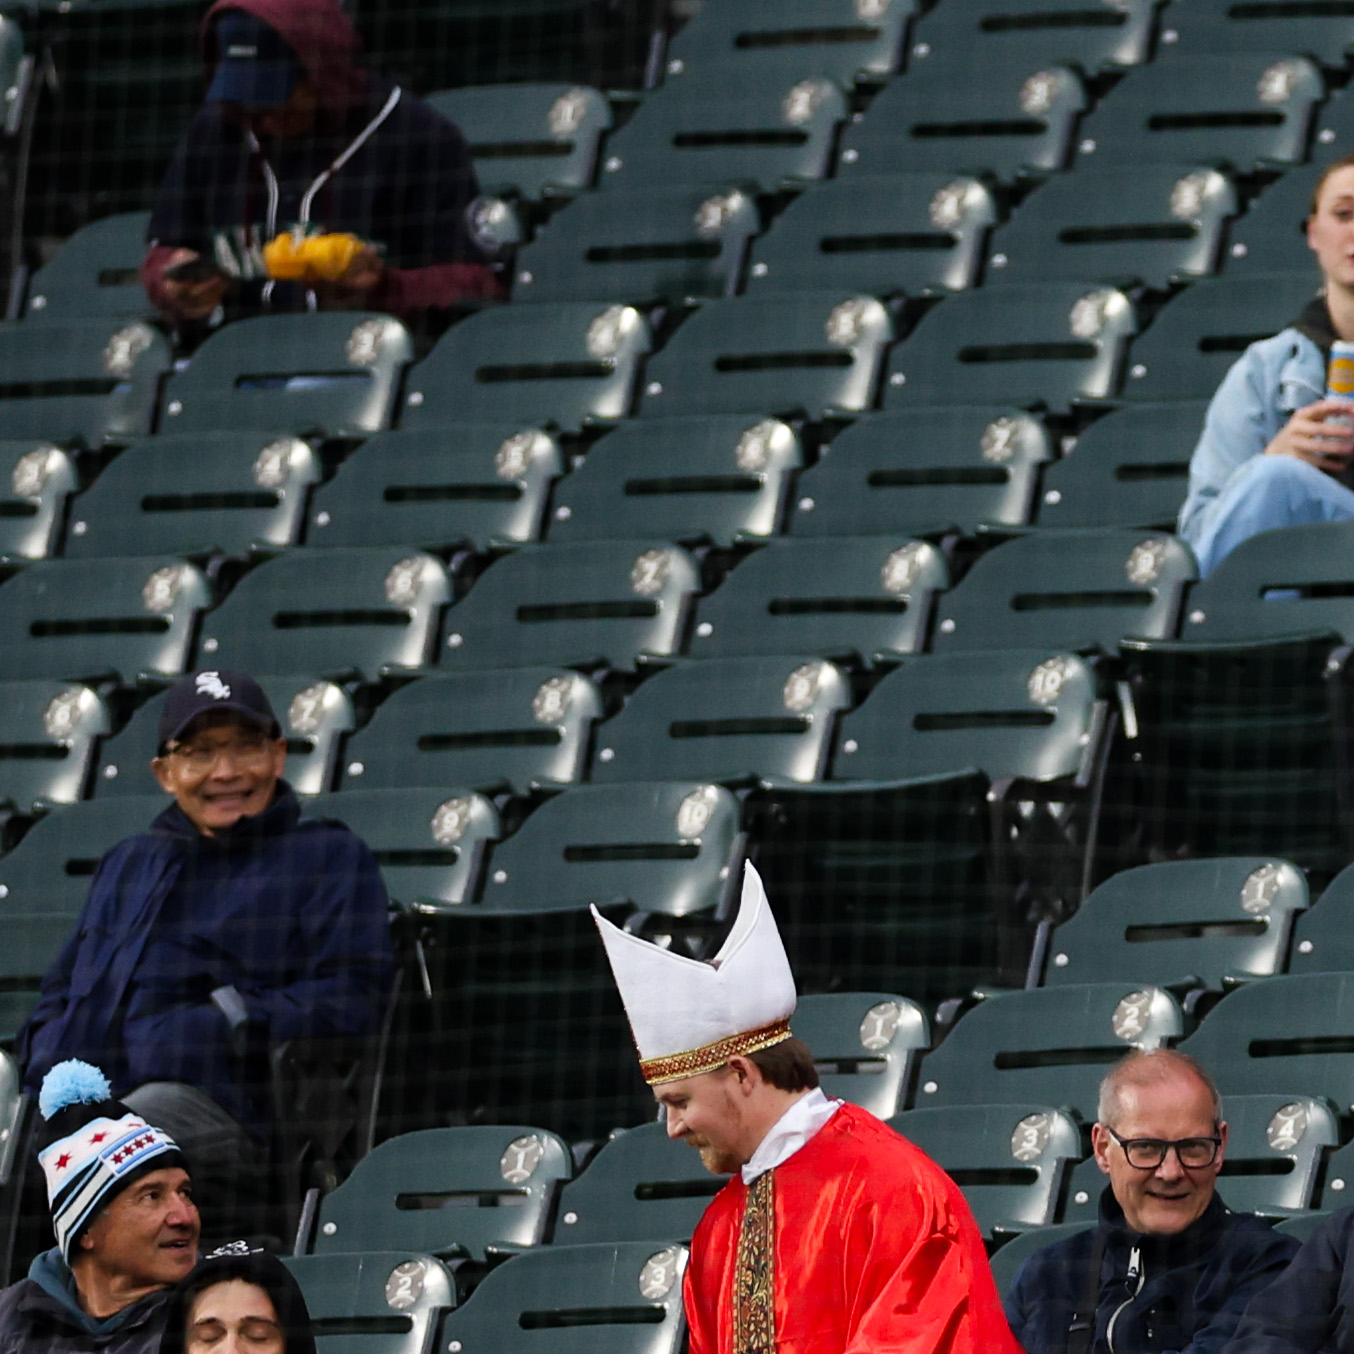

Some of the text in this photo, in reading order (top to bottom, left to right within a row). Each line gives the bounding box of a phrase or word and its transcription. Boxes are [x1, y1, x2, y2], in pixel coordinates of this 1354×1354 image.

[1036, 671, 1060, 692] 10
[303, 700, 315, 721] 7
[1124, 1006, 1138, 1027] 2
[1280, 1119, 1294, 1136] 4
[1023, 1128, 1037, 1149] 3
[398, 1277, 412, 1295] 2
[651, 1267, 665, 1288] 3
